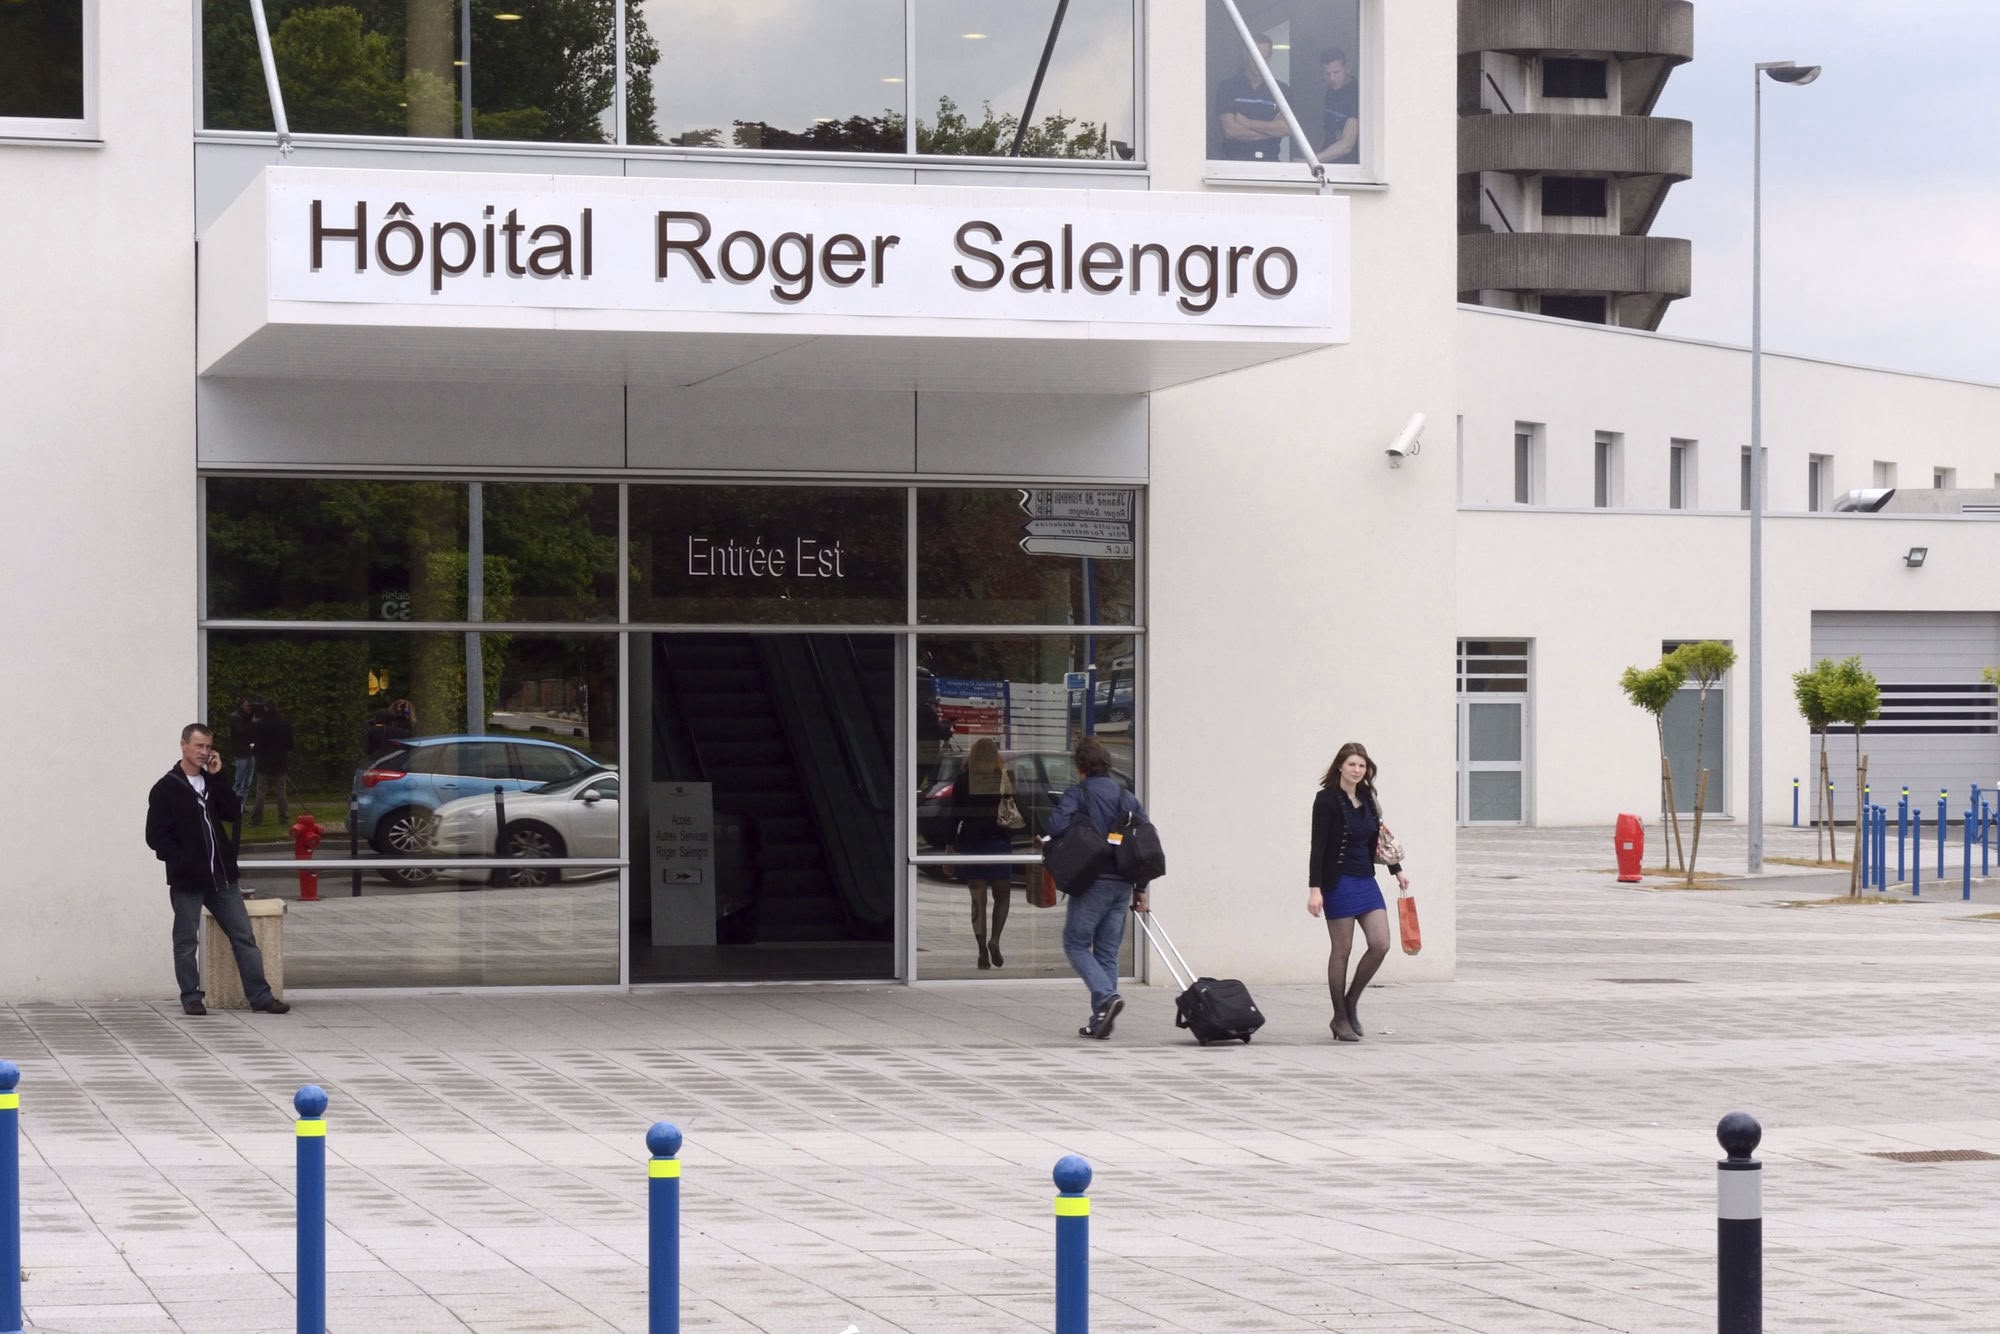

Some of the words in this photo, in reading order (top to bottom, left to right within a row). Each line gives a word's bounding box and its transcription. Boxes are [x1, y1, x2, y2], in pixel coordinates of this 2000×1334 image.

[310, 199, 593, 292] Hôpital
[656, 210, 901, 301] Roger
[952, 220, 1298, 314] Salengro
[688, 535, 786, 577] Entrée
[797, 537, 845, 578] Est
